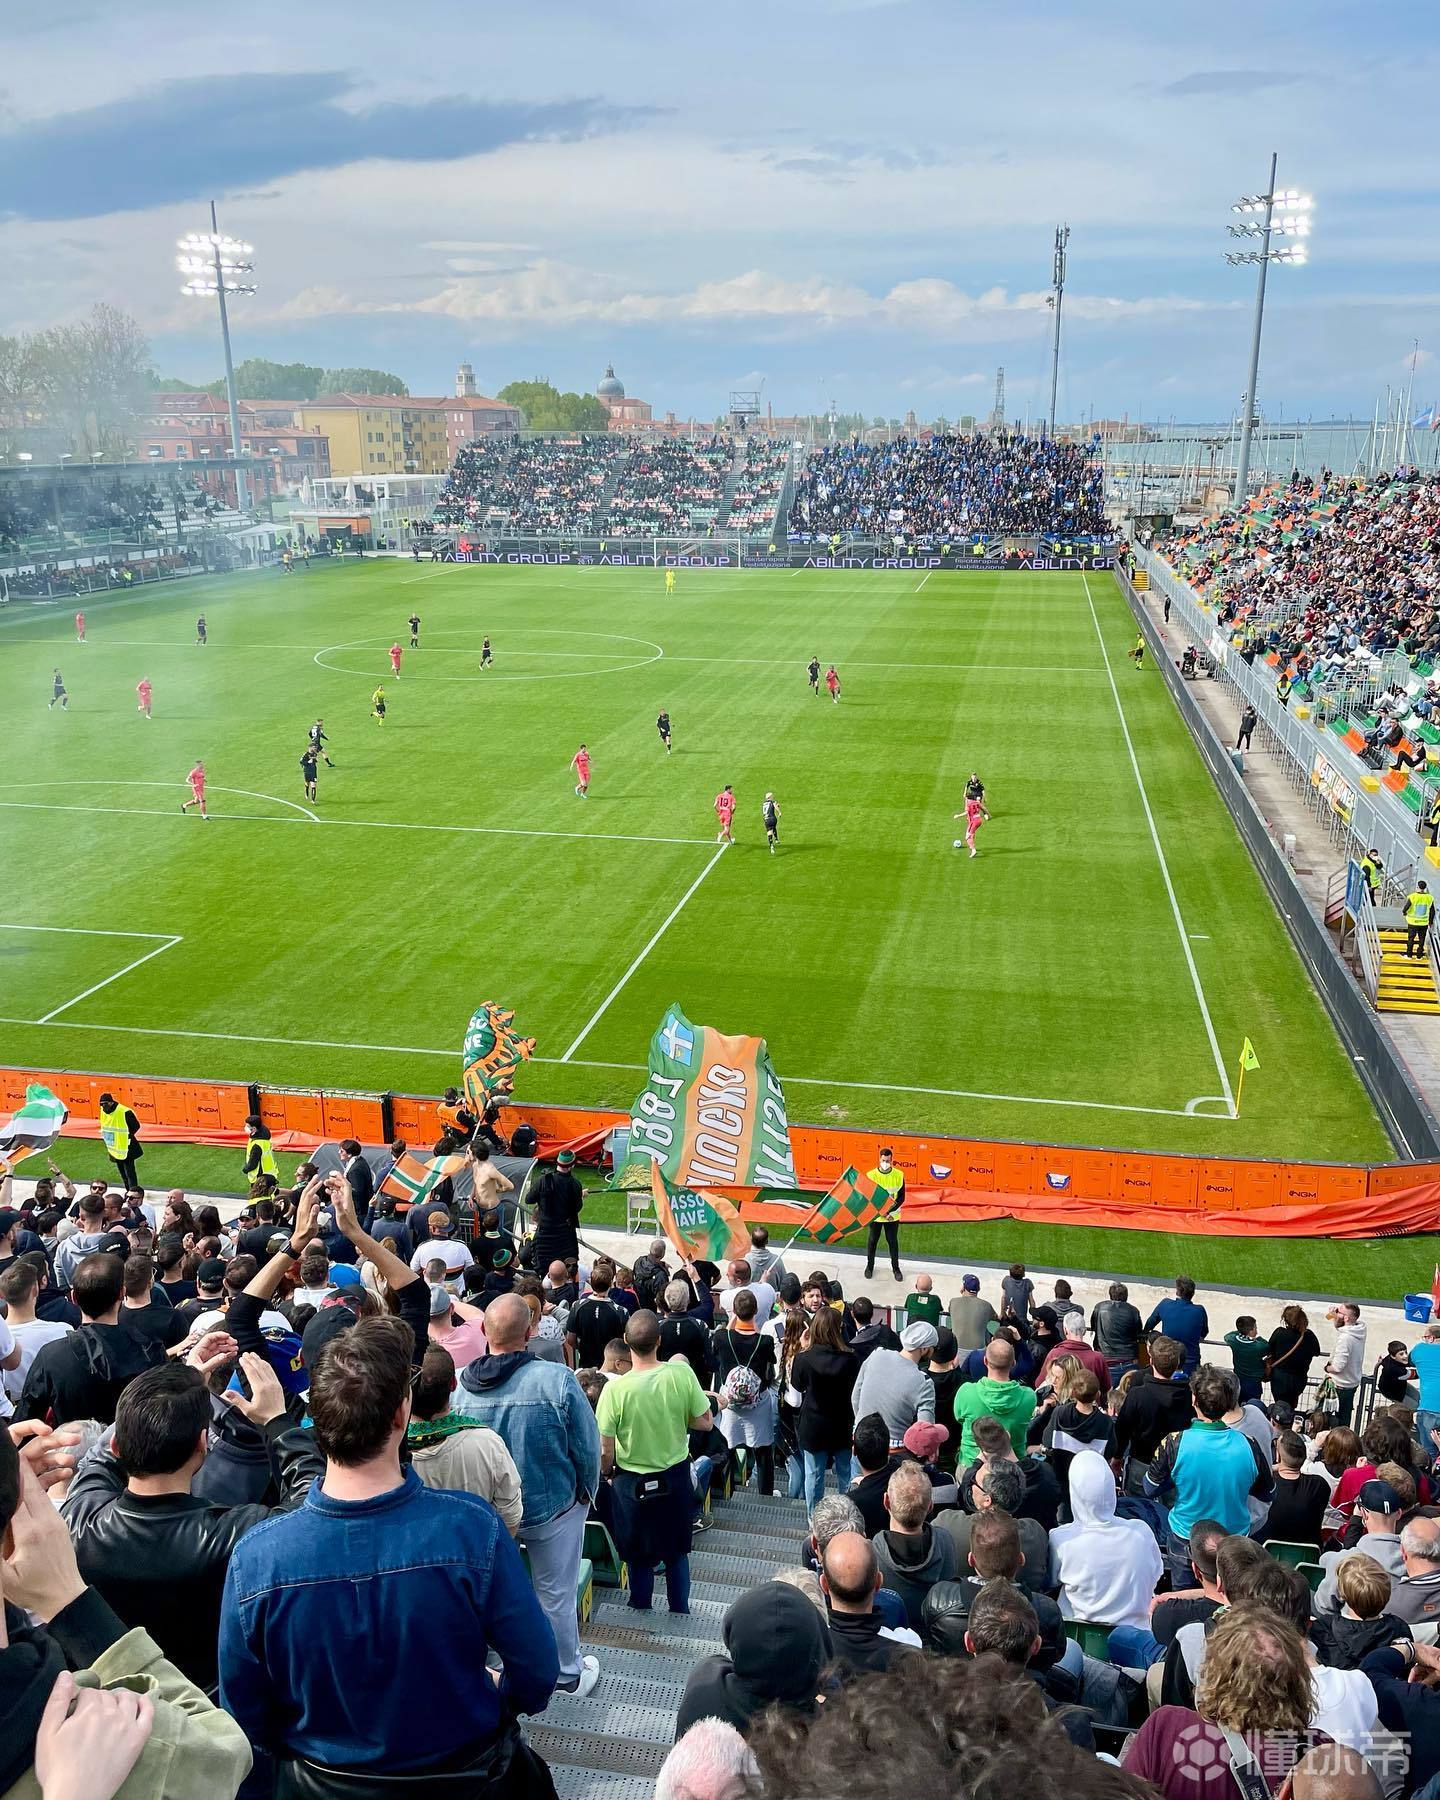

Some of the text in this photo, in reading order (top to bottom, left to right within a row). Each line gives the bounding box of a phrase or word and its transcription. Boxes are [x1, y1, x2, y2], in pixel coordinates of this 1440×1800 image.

[444, 552, 503, 563] ABILITY
[507, 553, 570, 564] GROUP
[600, 555, 660, 566] ABILITY
[665, 556, 729, 566] GROUP
[803, 557, 941, 569] ABILITY GROUP
[1018, 558, 1083, 570] ABILITY
[667, 1193, 705, 1211] ASSO
